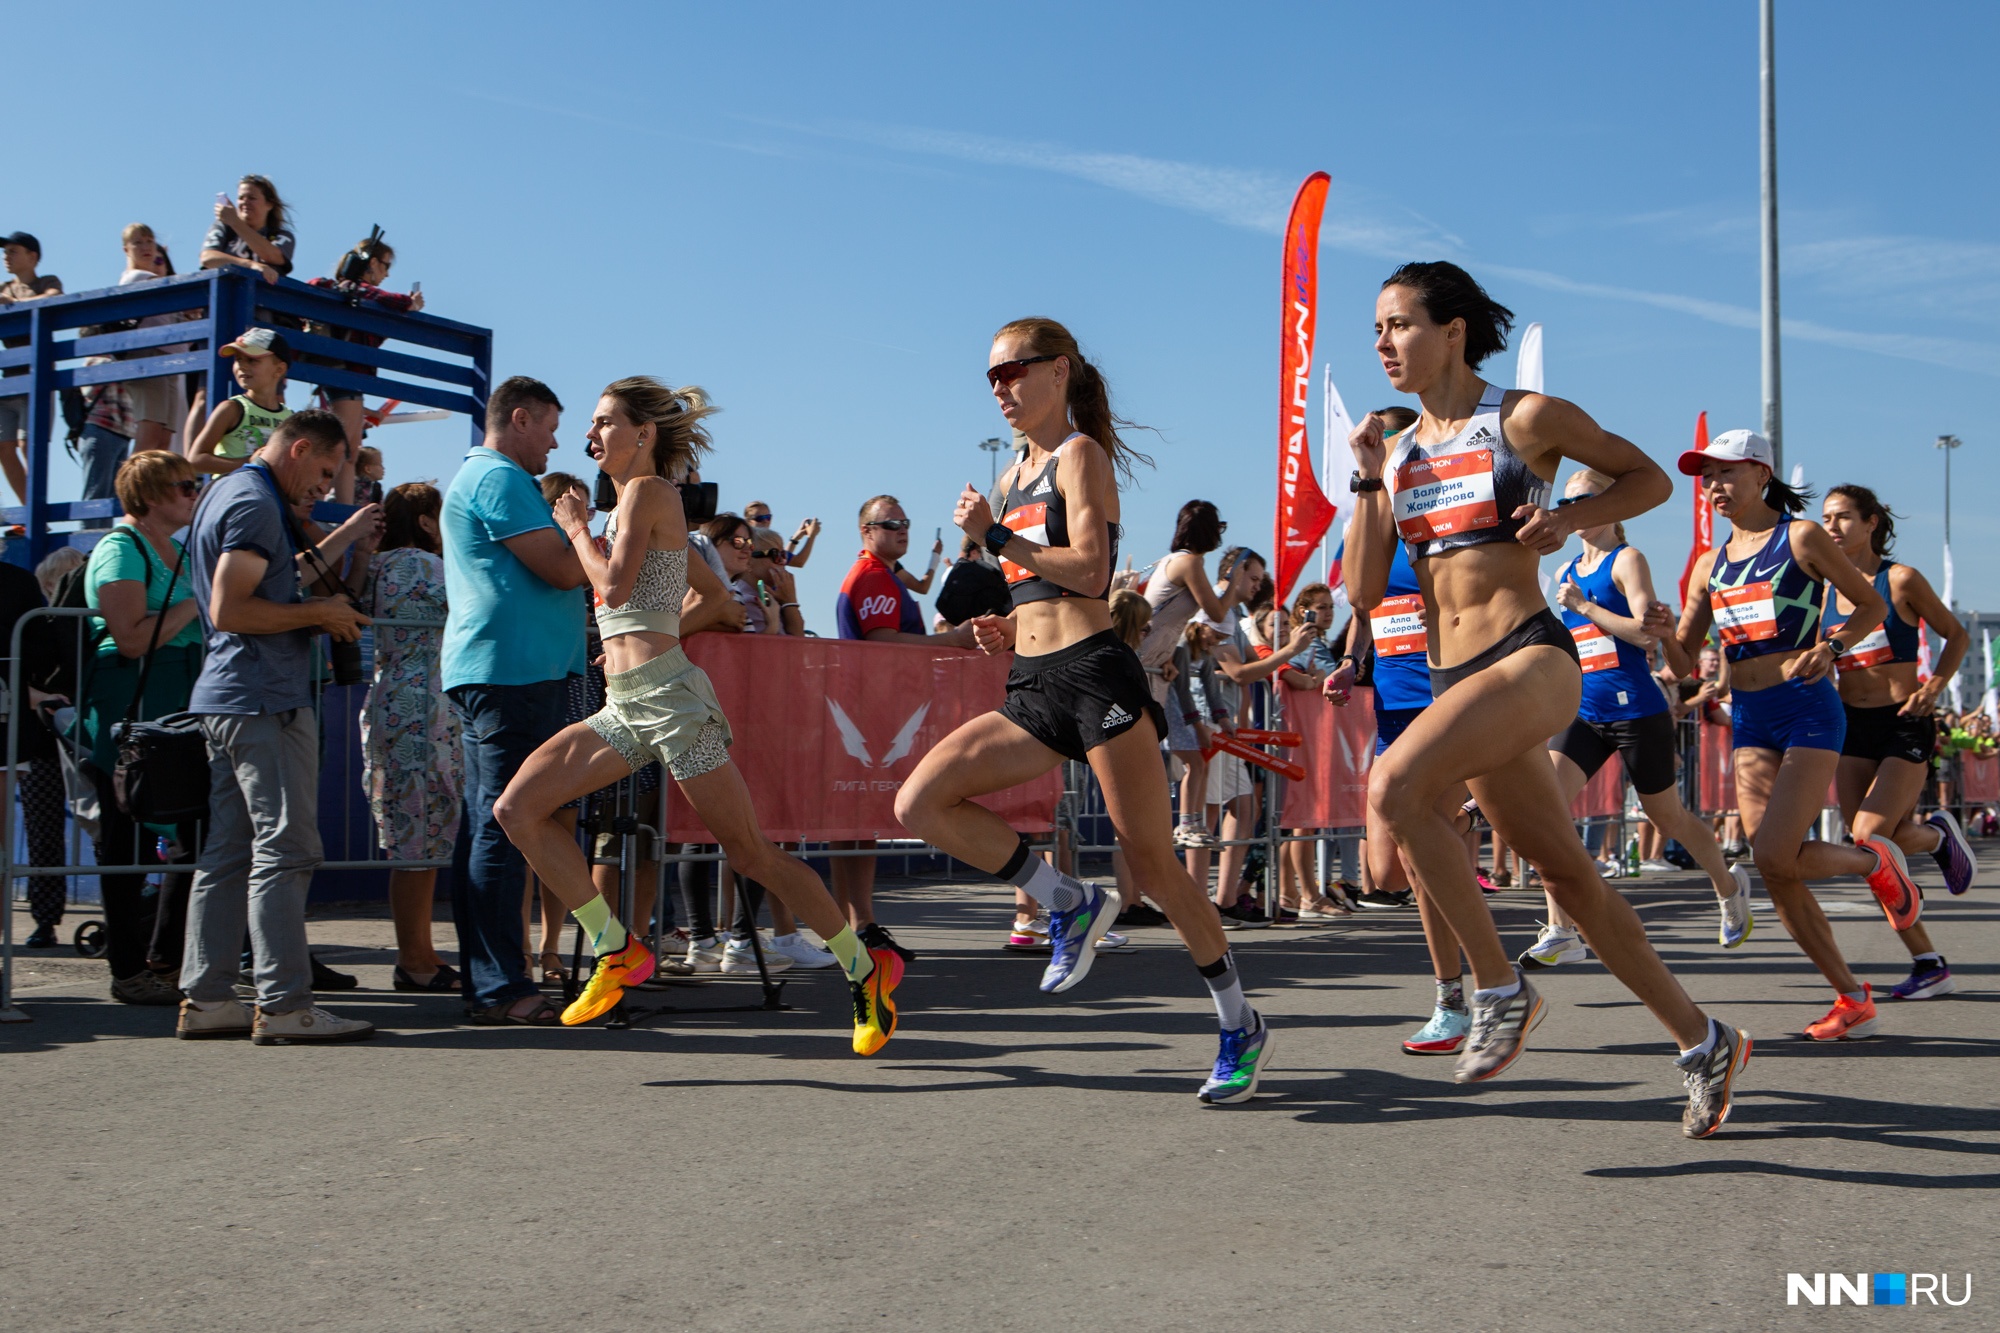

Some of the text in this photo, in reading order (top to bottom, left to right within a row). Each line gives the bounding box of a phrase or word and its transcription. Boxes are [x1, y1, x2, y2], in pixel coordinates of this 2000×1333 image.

[1466, 435, 1498, 447] adidas
[1409, 458, 1451, 474] MARATHON
[1032, 485, 1052, 497] adidas
[1412, 481, 1463, 500] Валерия
[1406, 490, 1475, 514] Жандарова
[858, 594, 898, 621] 800
[1725, 605, 1754, 615] Наталья
[1390, 616, 1411, 624] Алла
[1723, 613, 1759, 625] Леонтьева
[1383, 624, 1422, 633] Сидорова
[1101, 713, 1134, 729] adidas
[832, 780, 904, 792] ЛИГА ГЕРО
